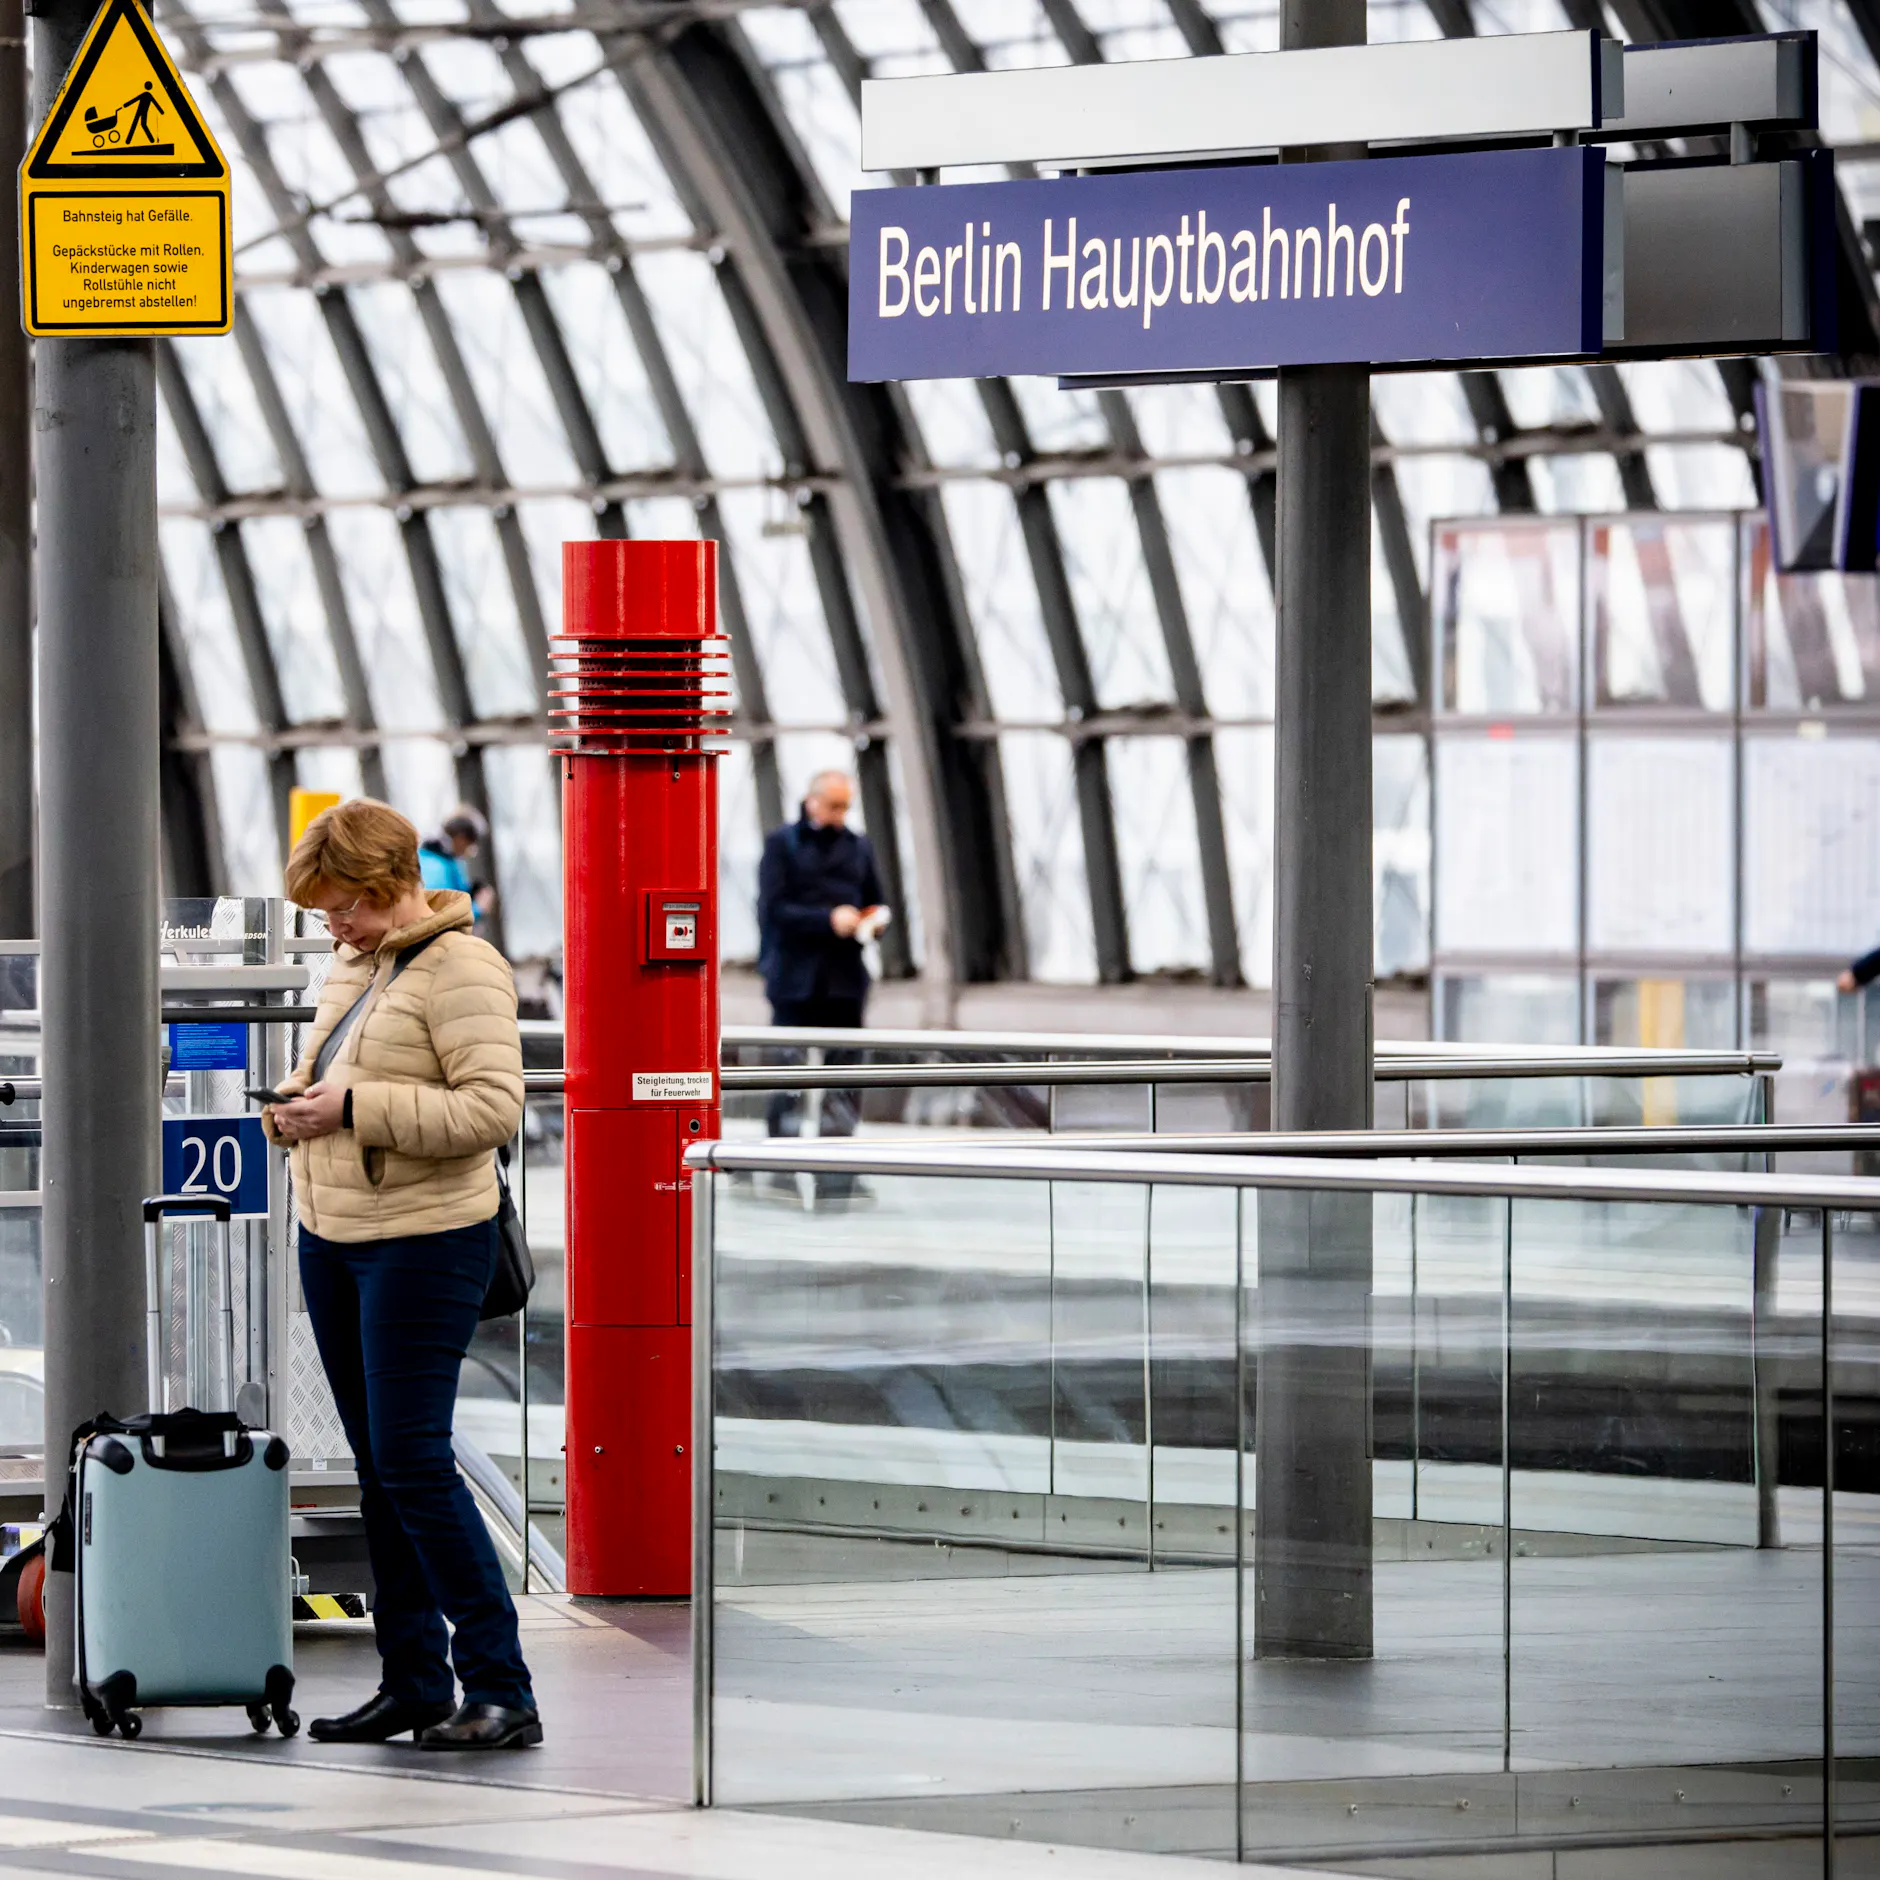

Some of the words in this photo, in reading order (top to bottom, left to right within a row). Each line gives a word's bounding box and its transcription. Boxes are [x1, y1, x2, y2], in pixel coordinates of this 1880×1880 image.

[64, 210, 122, 225] Bahnsteig
[127, 210, 144, 221] hat
[149, 210, 192, 221] Gefälle.
[53, 244, 136, 259] Gepäckstücke
[141, 244, 159, 255] mit
[71, 262, 149, 276] Kinderwagen
[154, 261, 187, 273] sowie
[879, 222, 1021, 317] Berlin
[1043, 198, 1410, 329] Hauptbahnhof
[84, 279, 143, 290] Rollstühle
[148, 278, 175, 290] nicht
[63, 296, 135, 311] ungebremst
[140, 295, 196, 307] abstellen!
[638, 1077, 685, 1086] Steigleitung,
[664, 1088, 700, 1096] Feuerwehr
[181, 1136, 242, 1192] 20
